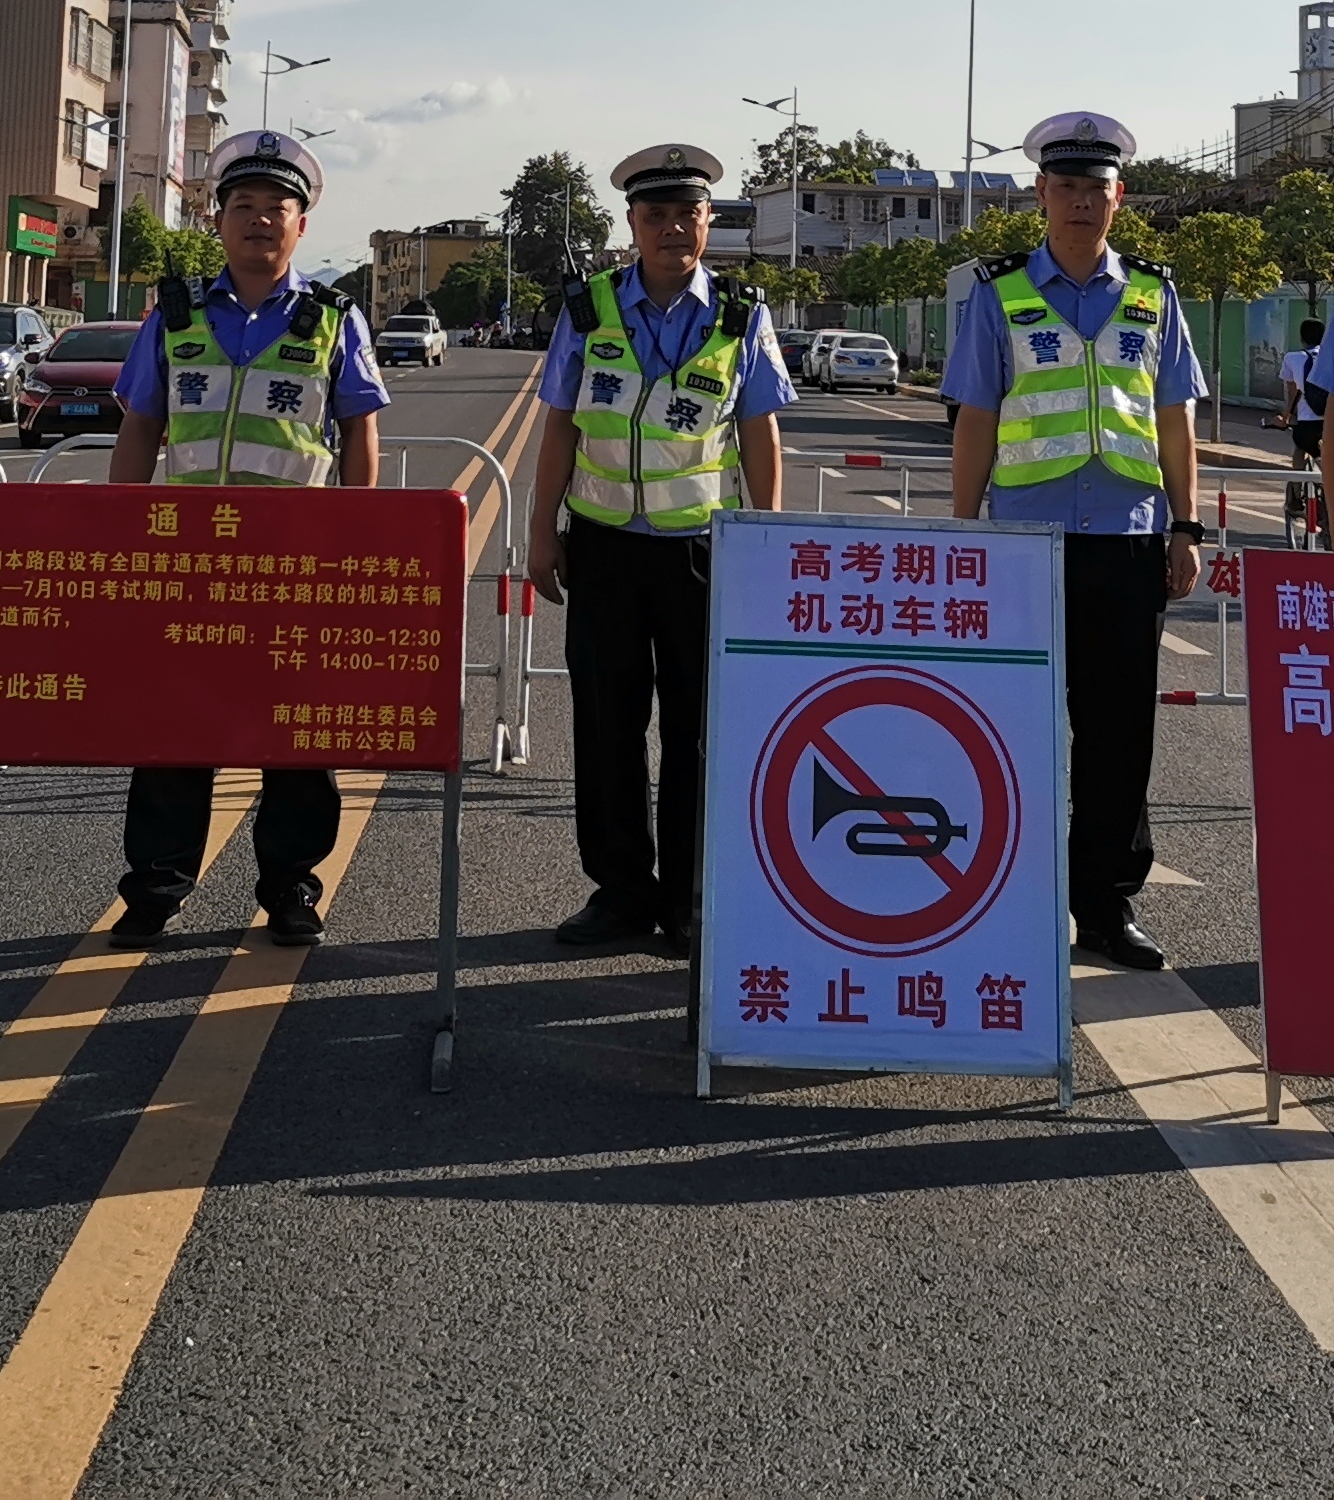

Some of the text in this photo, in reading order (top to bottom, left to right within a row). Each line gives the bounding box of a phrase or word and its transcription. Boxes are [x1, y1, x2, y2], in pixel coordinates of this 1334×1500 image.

[1028, 330, 1146, 365] 警察
[176, 370, 304, 415] 警察
[591, 370, 703, 433] 警察
[147, 502, 243, 538] 通告
[789, 539, 988, 587] 高考期间
[787, 591, 989, 640] 机动车辆
[268, 650, 308, 672] 下午
[272, 703, 438, 727] 南雄市招生委员会
[292, 730, 416, 752] 南雄市公安局
[739, 964, 1027, 1033] 禁止鸣笛
